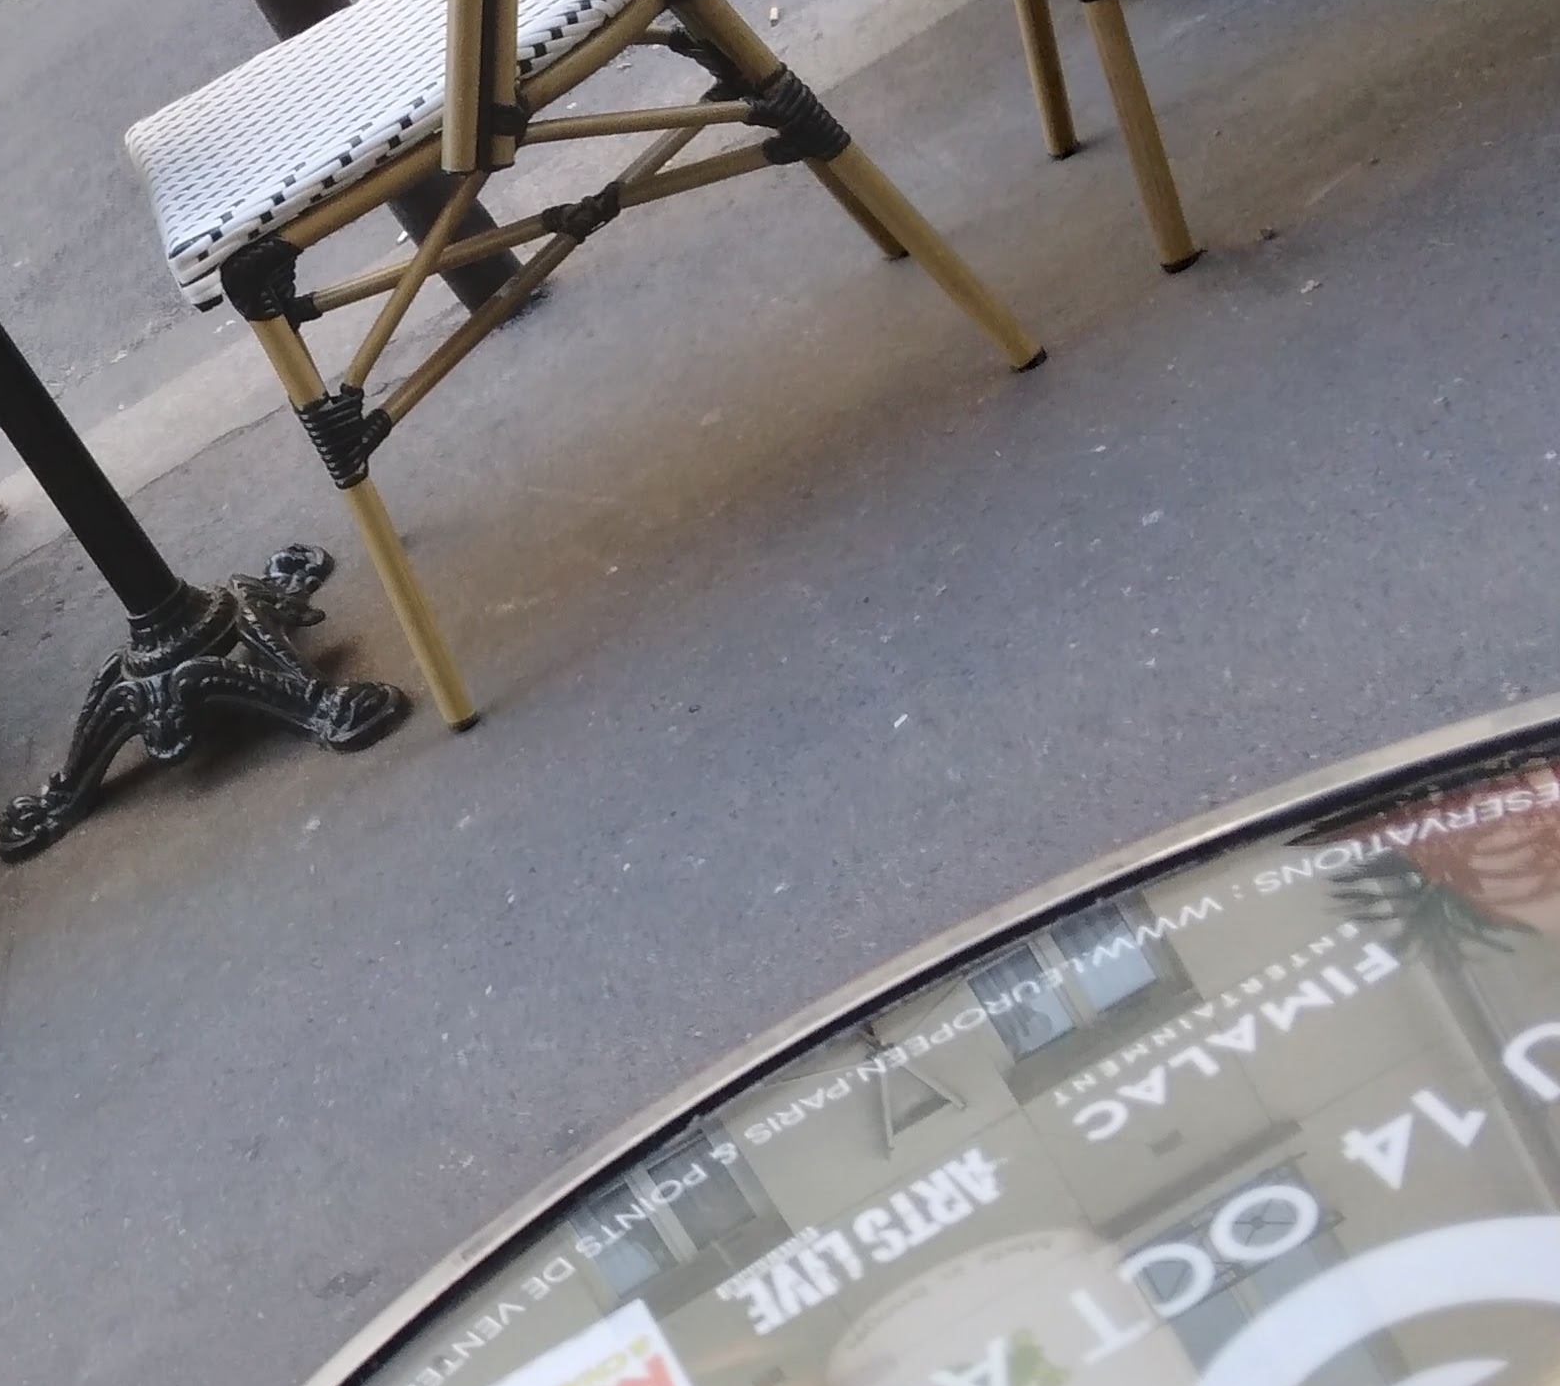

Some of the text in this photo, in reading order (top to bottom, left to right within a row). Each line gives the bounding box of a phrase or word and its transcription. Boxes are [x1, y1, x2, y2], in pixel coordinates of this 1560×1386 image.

[1072, 941, 1401, 1142] FIMALAC
[1341, 1087, 1487, 1191] 14
[574, 1162, 708, 1260] POINTS
[851, 1147, 1004, 1264] ARTS
[520, 1255, 576, 1301] DE
[745, 1228, 865, 1337] LIVE
[1068, 1183, 1321, 1368] OCT
